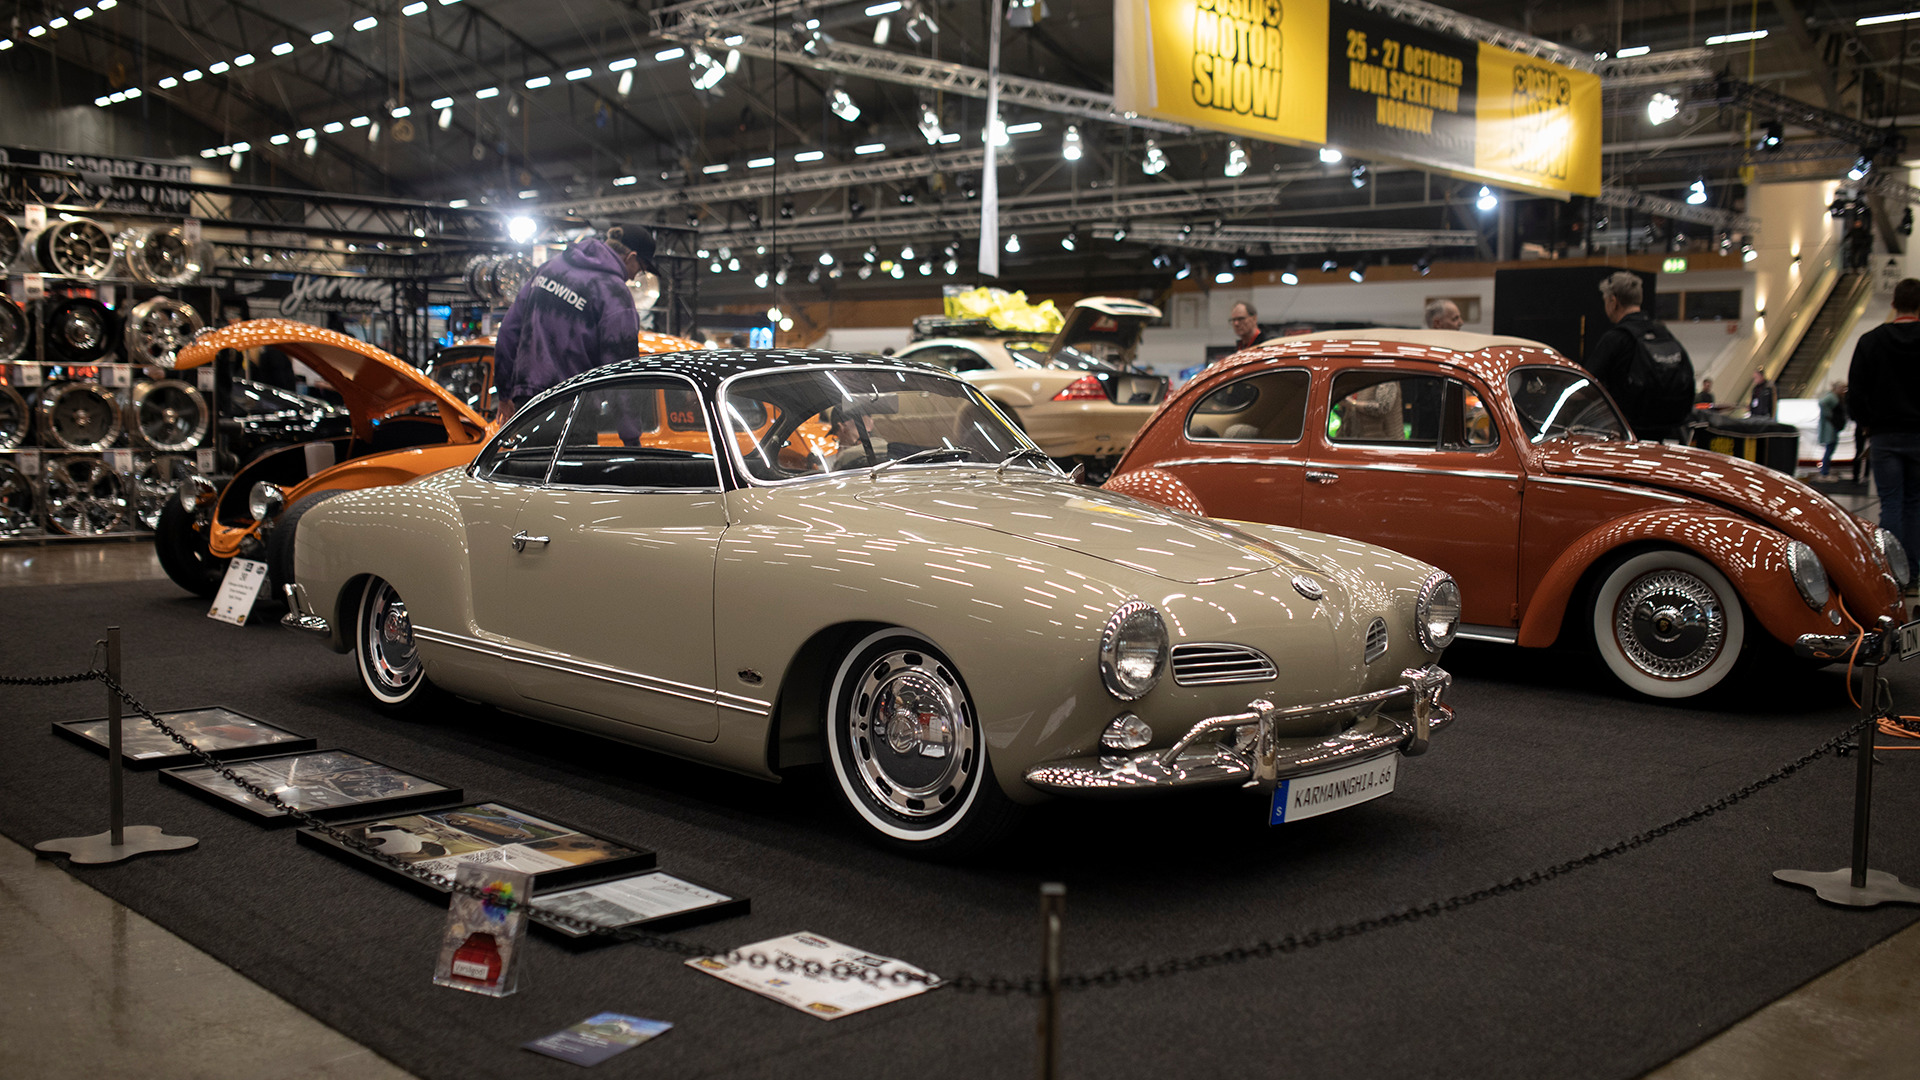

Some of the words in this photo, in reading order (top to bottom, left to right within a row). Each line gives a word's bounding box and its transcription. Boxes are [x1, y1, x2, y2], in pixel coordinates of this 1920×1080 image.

[1194, 9, 1283, 71] MOTOR
[1346, 29, 1367, 61] 25
[1382, 38, 1400, 69] 27
[1403, 44, 1463, 86] OCTOBER
[1191, 52, 1282, 120] SHOW
[1349, 60, 1388, 96] NOVA
[1389, 70, 1459, 113] SPEKTRUM
[1376, 96, 1434, 134] NORWAY
[670, 411, 695, 424] GAS
[1276, 806, 1282, 816] S
[1294, 766, 1391, 809] KARMANNGHIA.66
